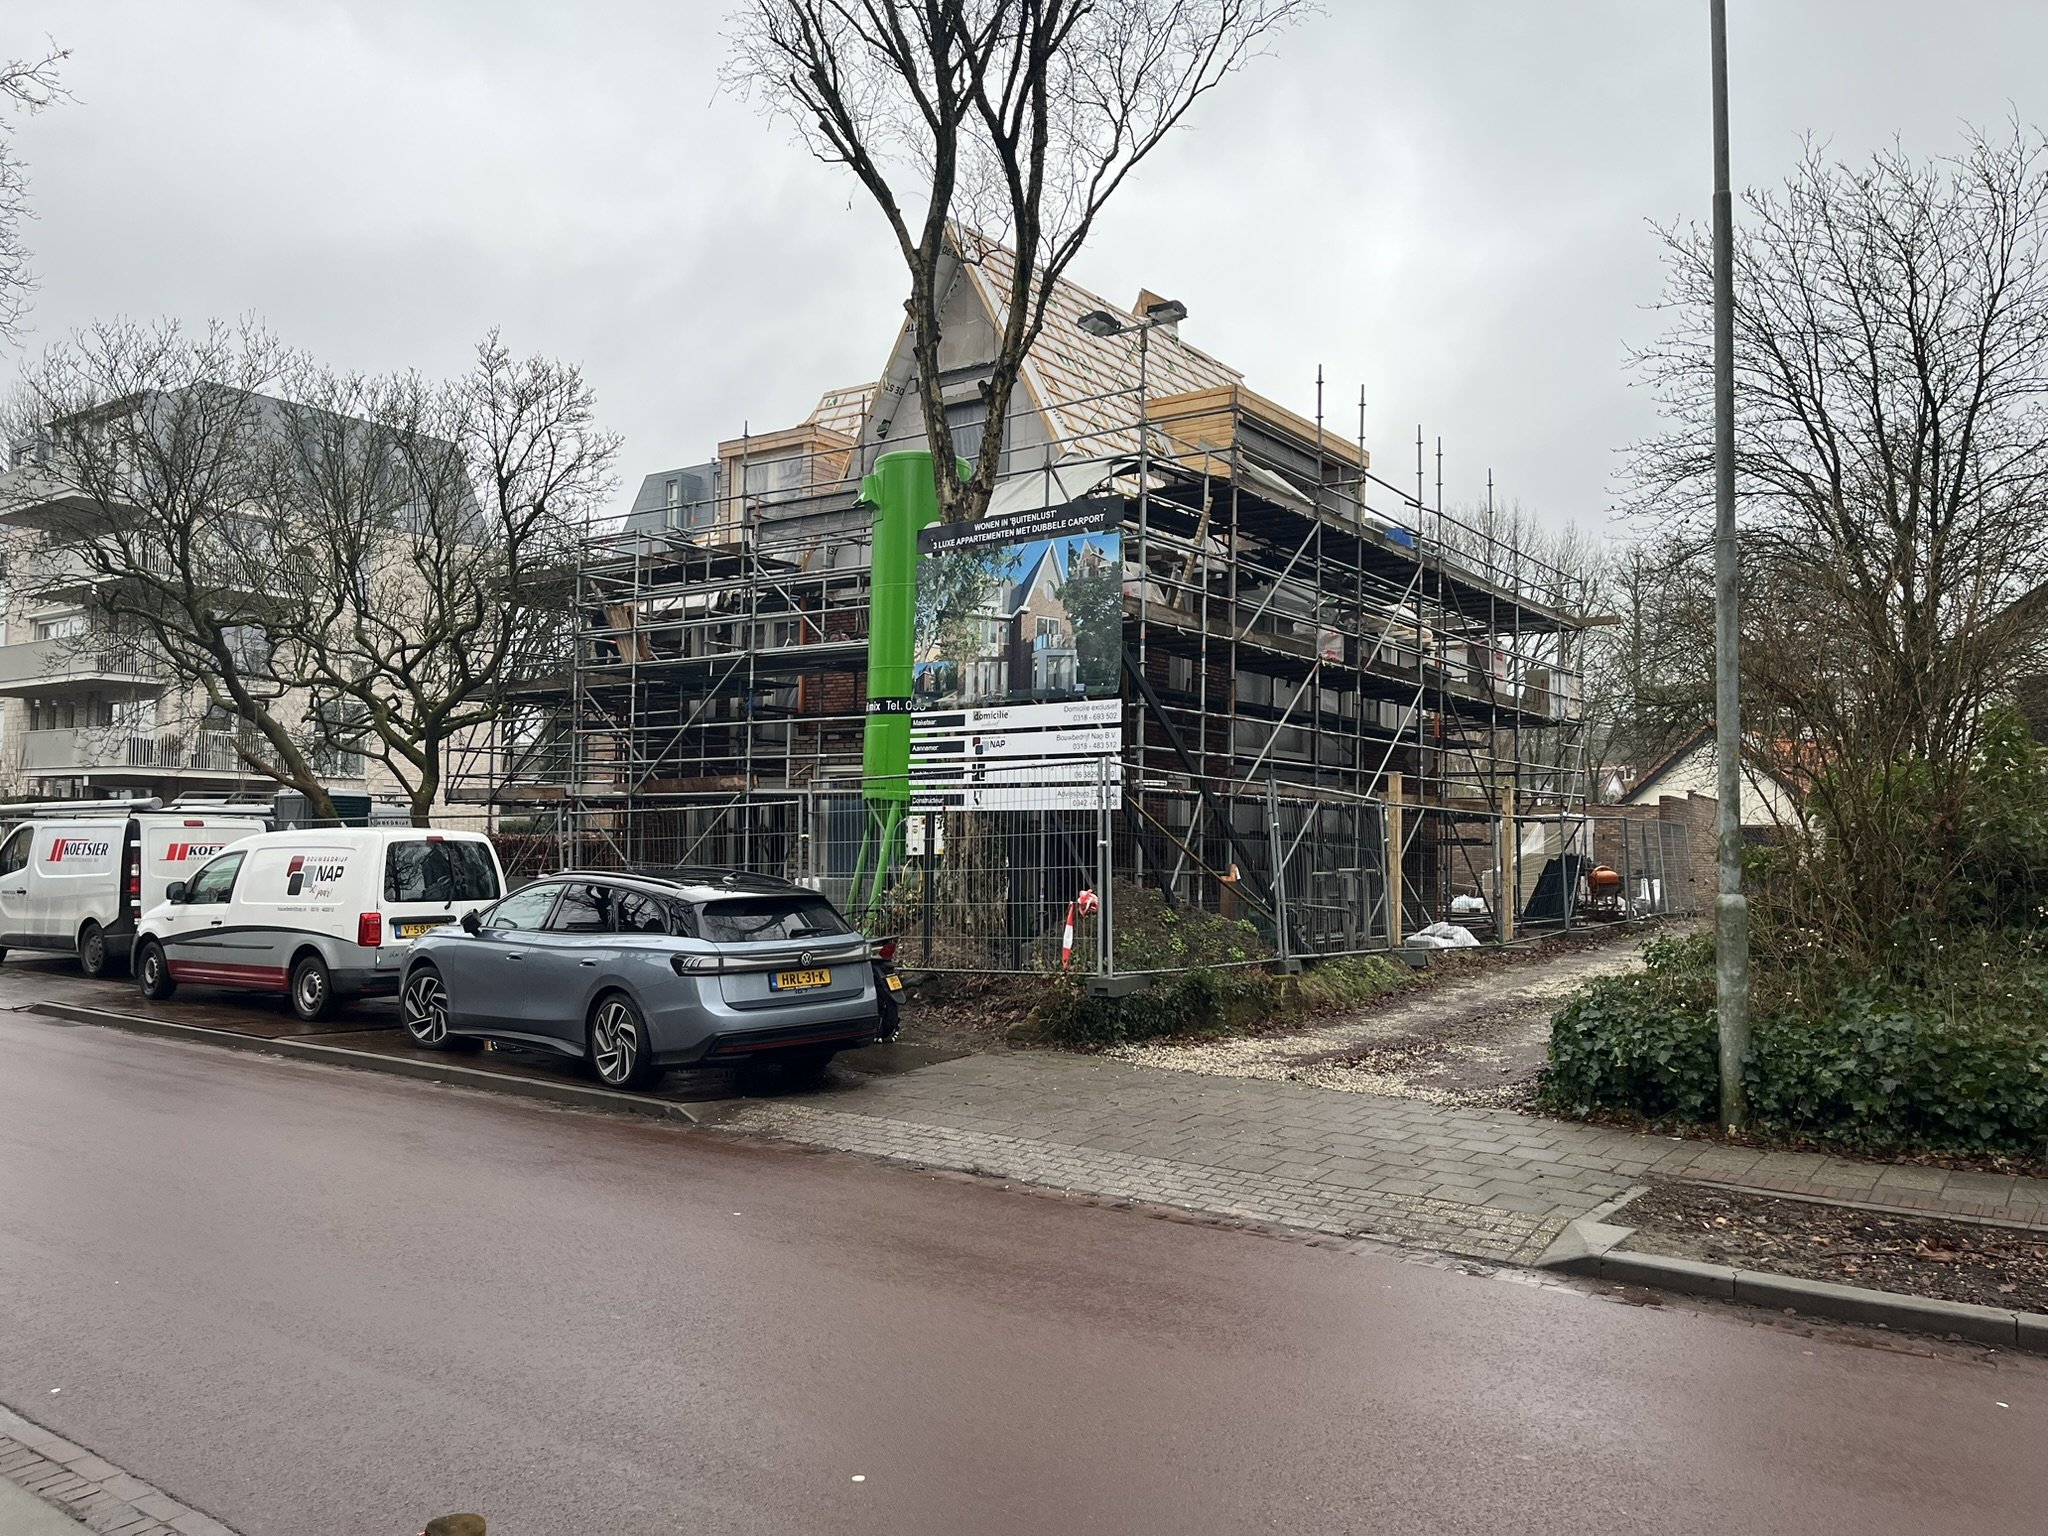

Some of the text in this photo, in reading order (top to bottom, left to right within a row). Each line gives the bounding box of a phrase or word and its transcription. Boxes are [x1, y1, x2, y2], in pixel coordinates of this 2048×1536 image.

[938, 538, 955, 548] LUXE
[956, 528, 1014, 545] APPARTEMENTEN
[1016, 526, 1031, 535] MET
[1032, 520, 1066, 532] DUBBELE
[1068, 514, 1105, 526] CARPORT
[974, 519, 1000, 531] WONEN
[1000, 518, 1008, 527] IN
[886, 700, 903, 711] Tel.
[1064, 704, 1090, 712] Domicilie
[974, 710, 1009, 720] domicilie
[990, 740, 1006, 748] NAP
[64, 842, 108, 856] KOETSIER
[314, 865, 344, 882] NAP
[782, 970, 826, 986] HRL-31-K
